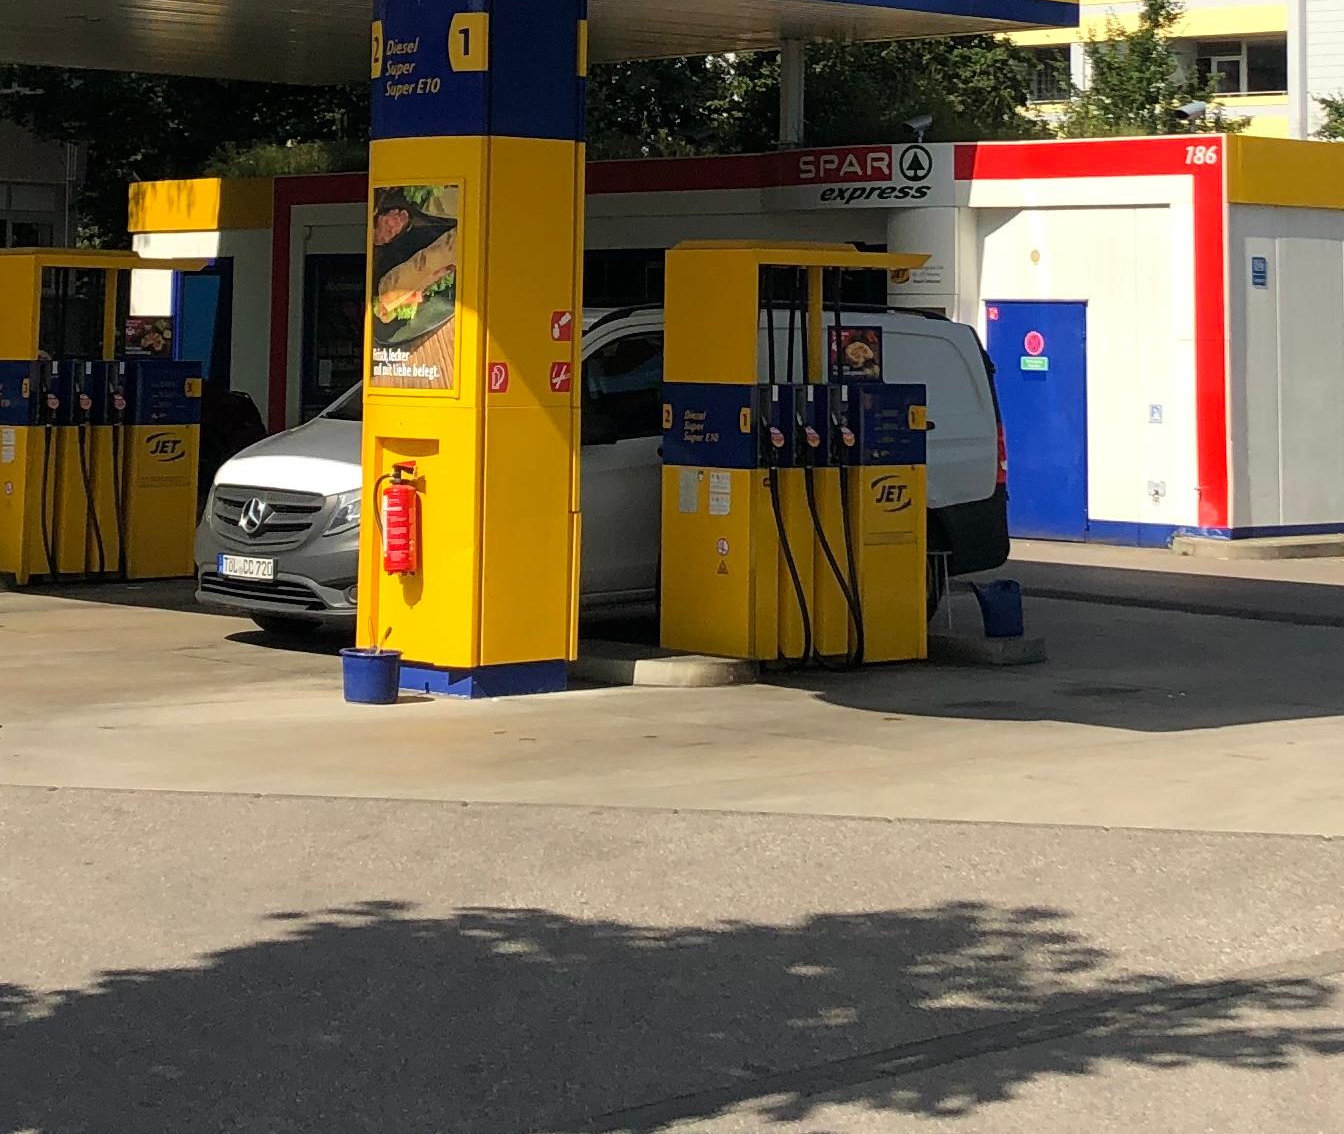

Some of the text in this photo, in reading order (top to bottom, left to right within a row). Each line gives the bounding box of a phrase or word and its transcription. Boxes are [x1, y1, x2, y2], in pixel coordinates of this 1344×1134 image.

[386, 36, 420, 56] Diesel
[458, 28, 470, 56] 1
[385, 60, 416, 80] Super
[385, 77, 441, 101] Super E10
[1185, 145, 1218, 165] 186
[799, 152, 890, 179] SPAR
[820, 185, 932, 204] express
[150, 439, 182, 454] JET
[875, 485, 908, 504] JET
